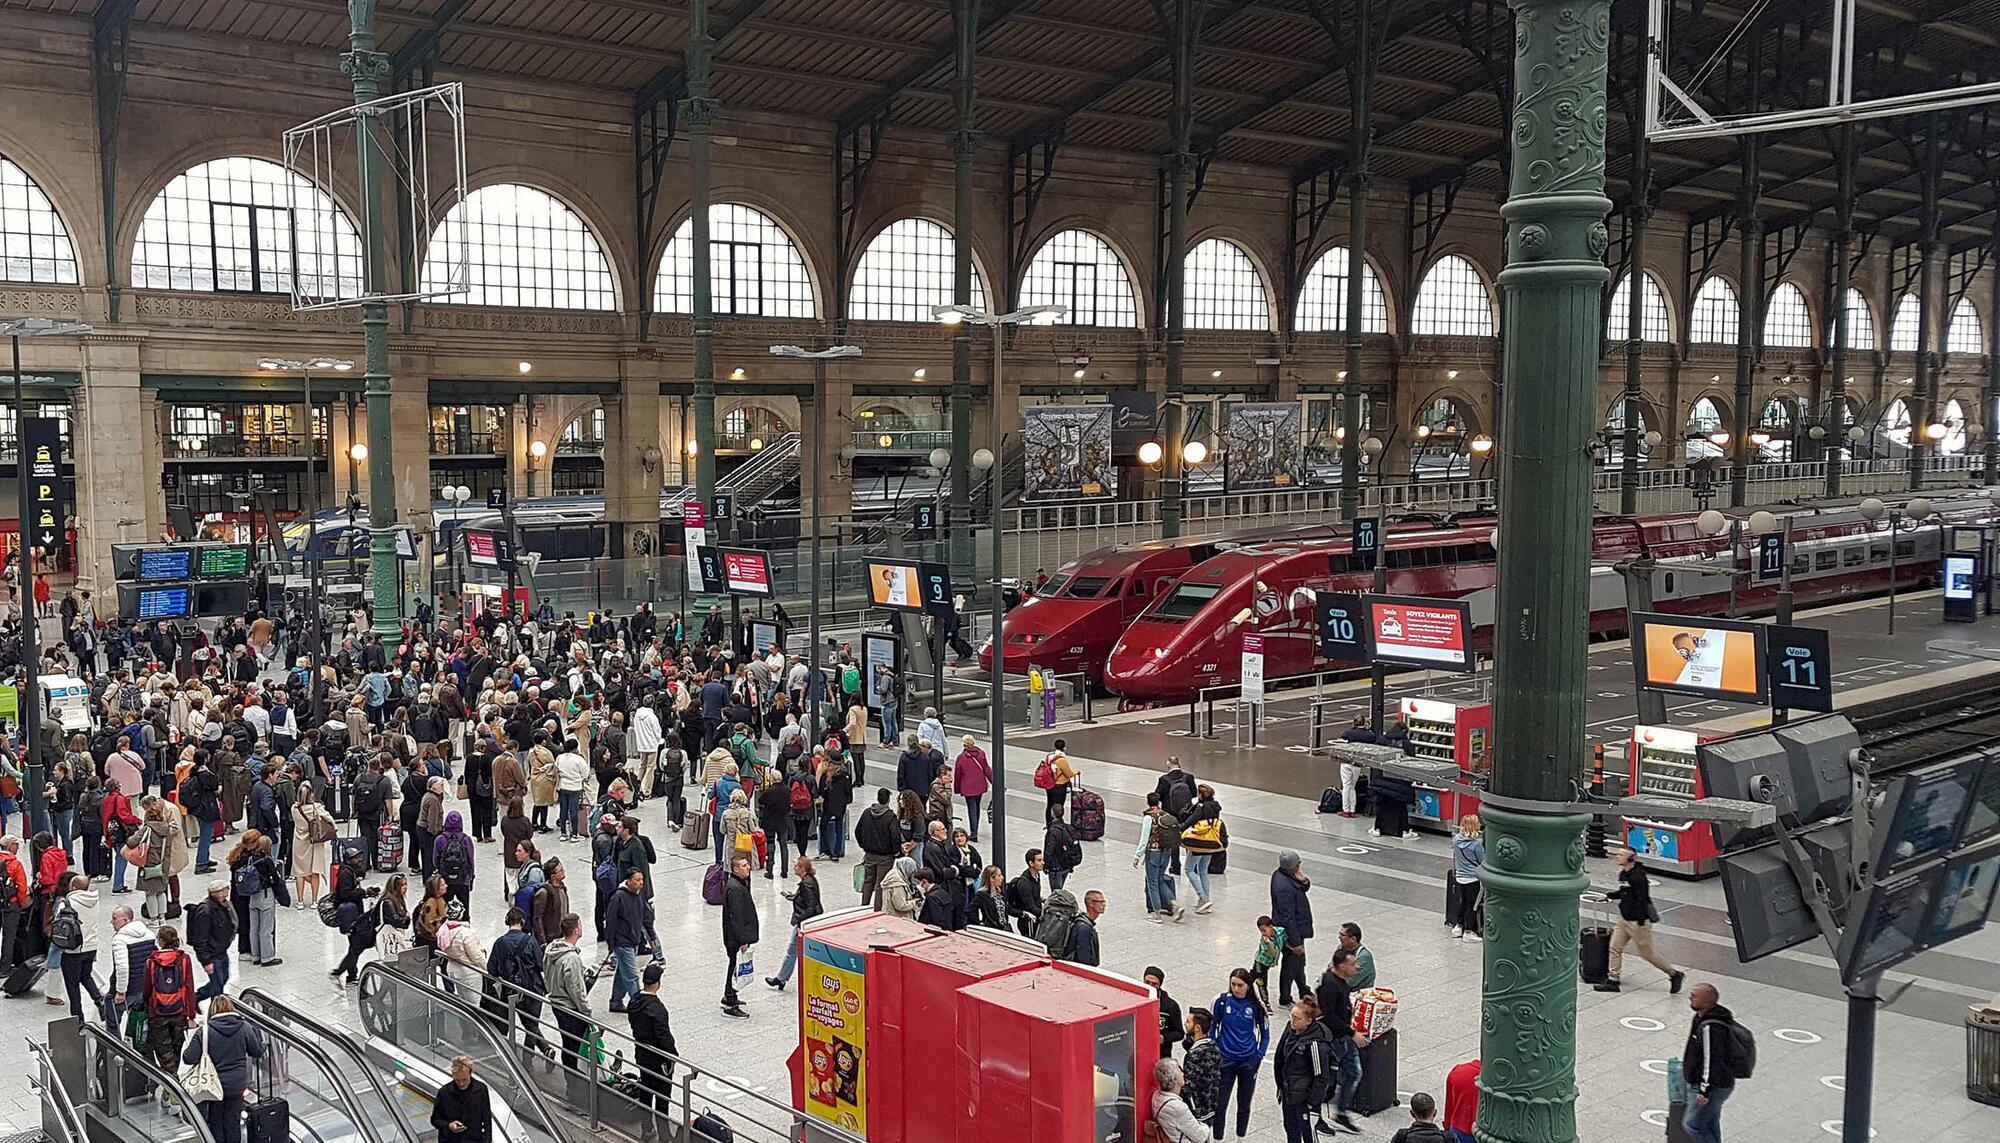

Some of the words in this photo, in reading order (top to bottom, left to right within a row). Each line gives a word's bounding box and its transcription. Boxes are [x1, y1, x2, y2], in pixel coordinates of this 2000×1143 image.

[39, 485, 51, 499] P
[237, 481, 243, 490] 5
[493, 494, 500, 504] 7
[717, 504, 725, 516] 8
[921, 513, 928, 527] 9
[1358, 530, 1374, 547] 10
[501, 546, 508, 559] 7
[1765, 548, 1779, 568] 11
[706, 564, 714, 578] 8
[933, 584, 943, 600] 9
[1405, 610, 1426, 618] SOYEZ
[1426, 611, 1458, 620] VIGILANTS
[1327, 618, 1354, 640] 10
[1202, 663, 1217, 672] 4321
[1781, 658, 1816, 685] 11
[809, 996, 817, 1005] La
[816, 997, 839, 1012] format
[811, 1006, 833, 1018] parfait
[817, 1013, 844, 1027] voyages
